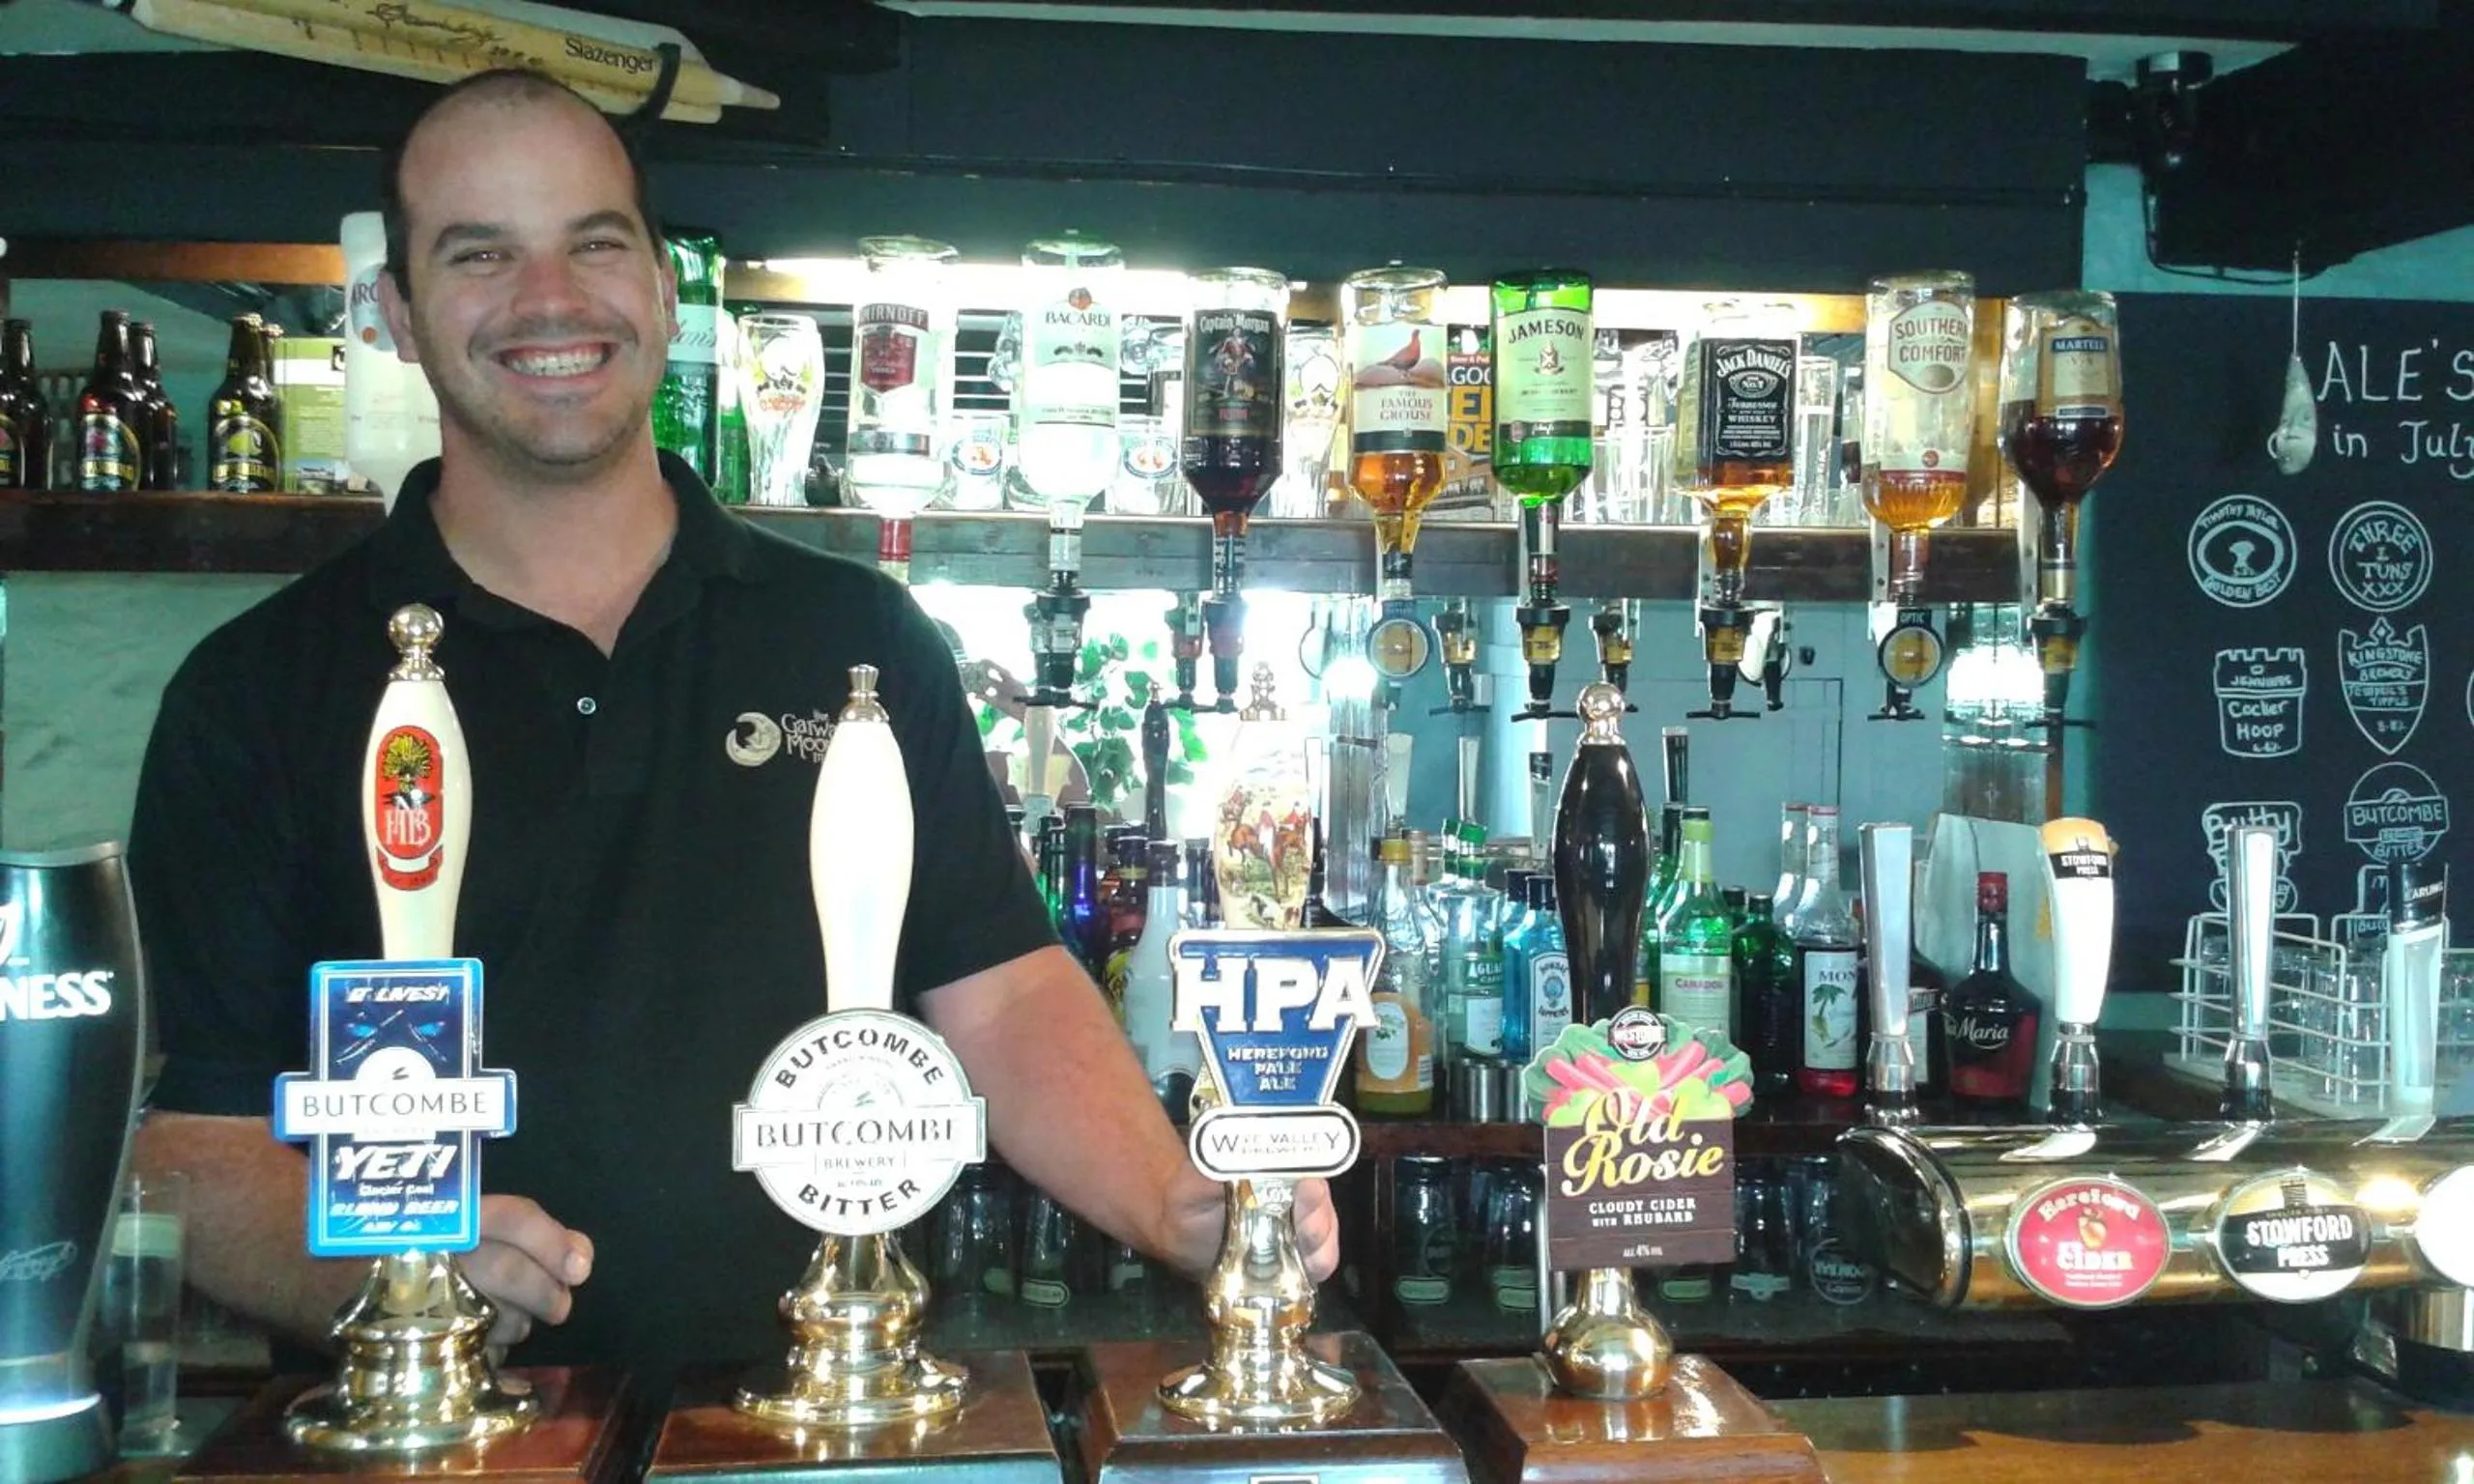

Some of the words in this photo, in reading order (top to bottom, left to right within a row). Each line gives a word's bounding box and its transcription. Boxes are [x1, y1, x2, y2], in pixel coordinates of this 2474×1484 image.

[563, 37, 656, 74] Slazenger
[859, 303, 928, 326] MIRNOFF
[1508, 319, 1585, 344] JAMESON
[1716, 355, 1745, 378] JACK
[2316, 338, 2474, 402] ALE'S
[2333, 424, 2368, 457] in
[2352, 804, 2443, 826] BUTCOMBE
[1170, 956, 1381, 1032] HPA
[1957, 1016, 2009, 1043] Maria
[775, 1029, 944, 1089] BUTCOMBE
[1227, 1046, 1329, 1062] HEREFORD
[1254, 1062, 1303, 1075] PALE
[1259, 1077, 1296, 1091] ALE
[302, 1091, 487, 1118] BUTCOMBE
[1584, 1086, 1685, 1146] Old
[334, 1145, 458, 1181] YETI
[1561, 1131, 1725, 1197] Rosie
[798, 1179, 921, 1215] BITTER
[1589, 1200, 1644, 1214] CLOUDY
[1650, 1198, 1696, 1212] CIDER
[2246, 1213, 2353, 1248] STOWFORD
[2277, 1244, 2329, 1268] PRESS
